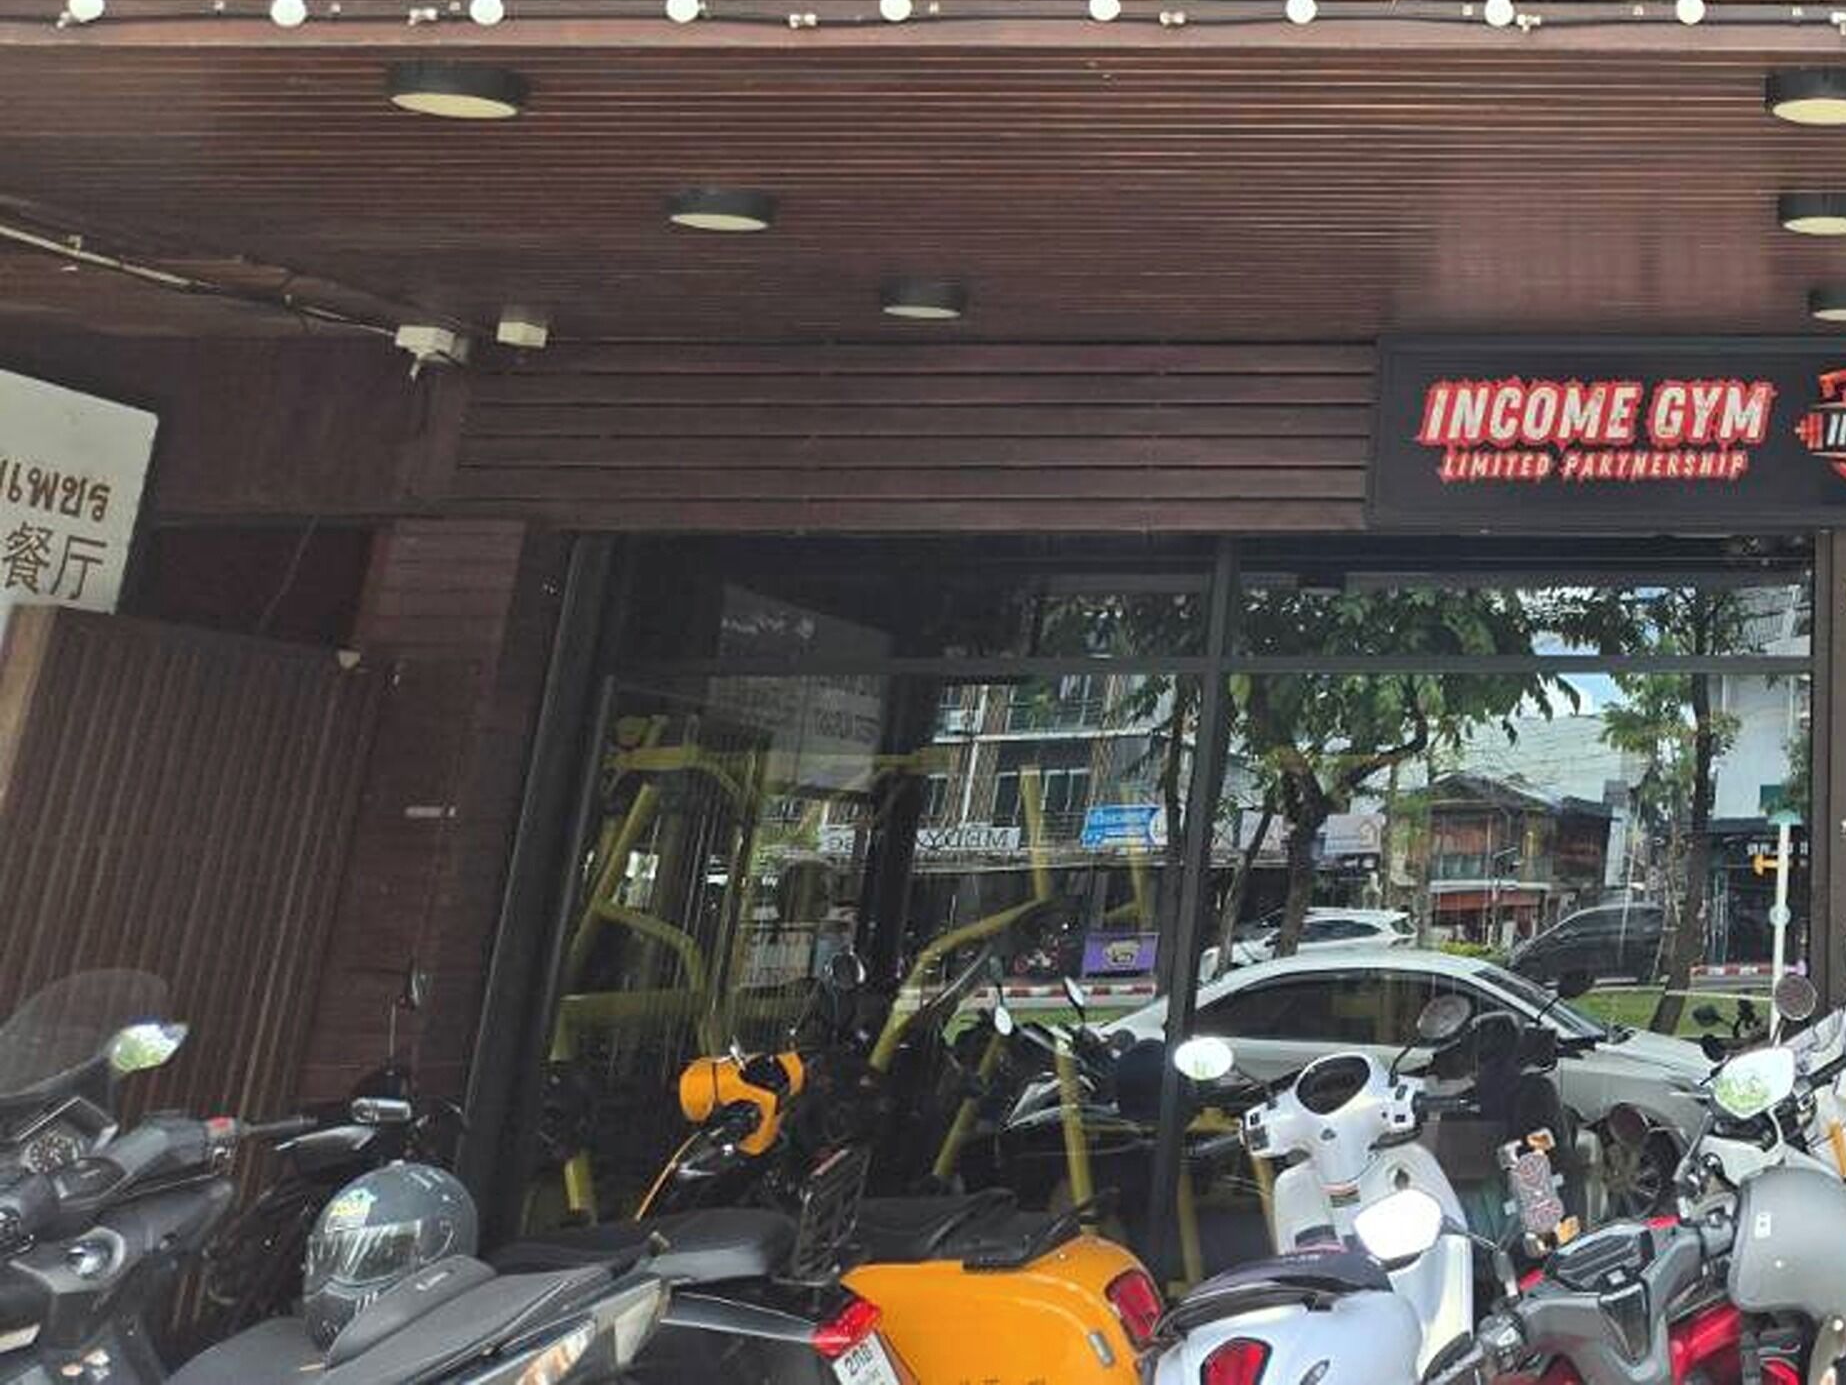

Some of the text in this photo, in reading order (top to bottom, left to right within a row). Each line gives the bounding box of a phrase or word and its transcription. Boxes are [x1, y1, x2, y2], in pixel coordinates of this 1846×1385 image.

[1423, 383, 1770, 442] INCOME GYM
[1443, 451, 1748, 478] LIMITED PARTNERSHIP
[2, 520, 106, 601] 餐厅
